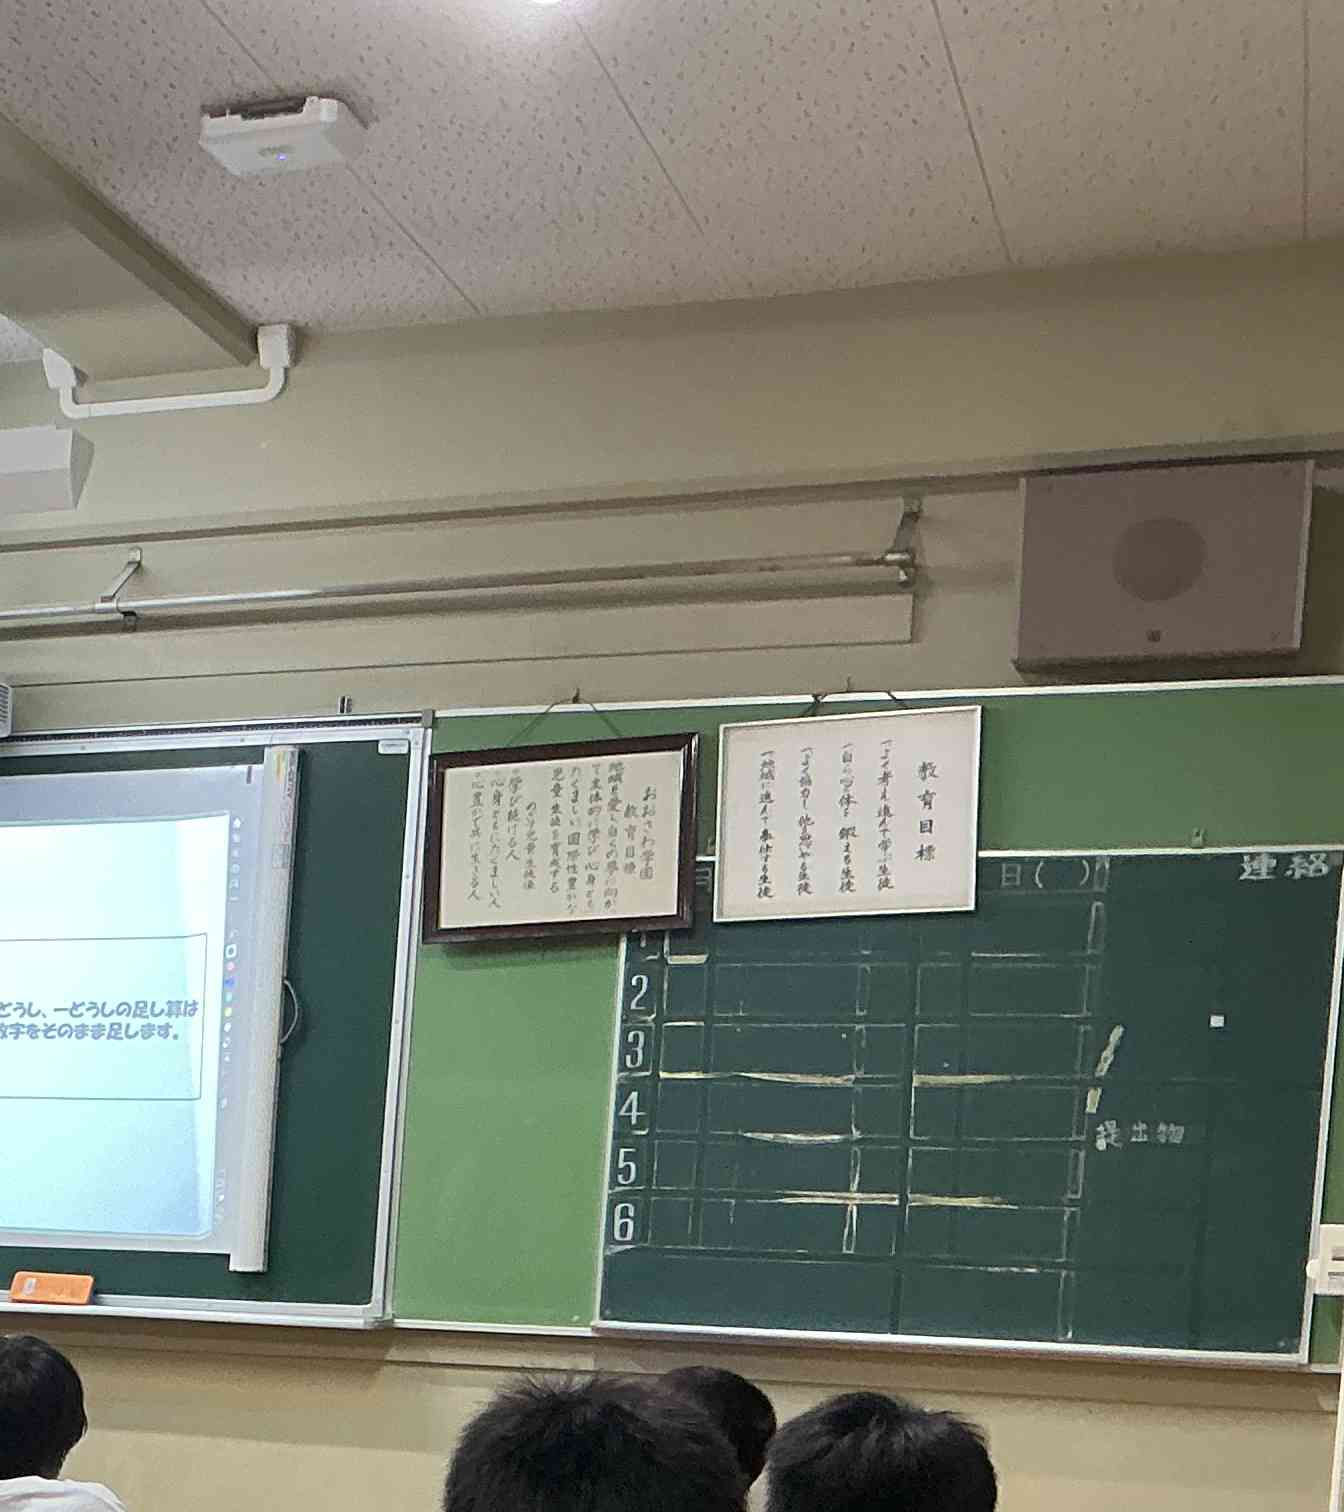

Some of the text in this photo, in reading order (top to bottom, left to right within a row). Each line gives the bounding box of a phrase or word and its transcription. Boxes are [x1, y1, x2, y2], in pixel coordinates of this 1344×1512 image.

[914, 760, 940, 865] 教育目標
[1239, 852, 1330, 881] 連絡
[630, 974, 649, 1011] 2
[625, 1030, 645, 1069] 3
[619, 1091, 646, 1126] 4
[616, 1148, 637, 1185] 5
[613, 1203, 635, 1241] 6
